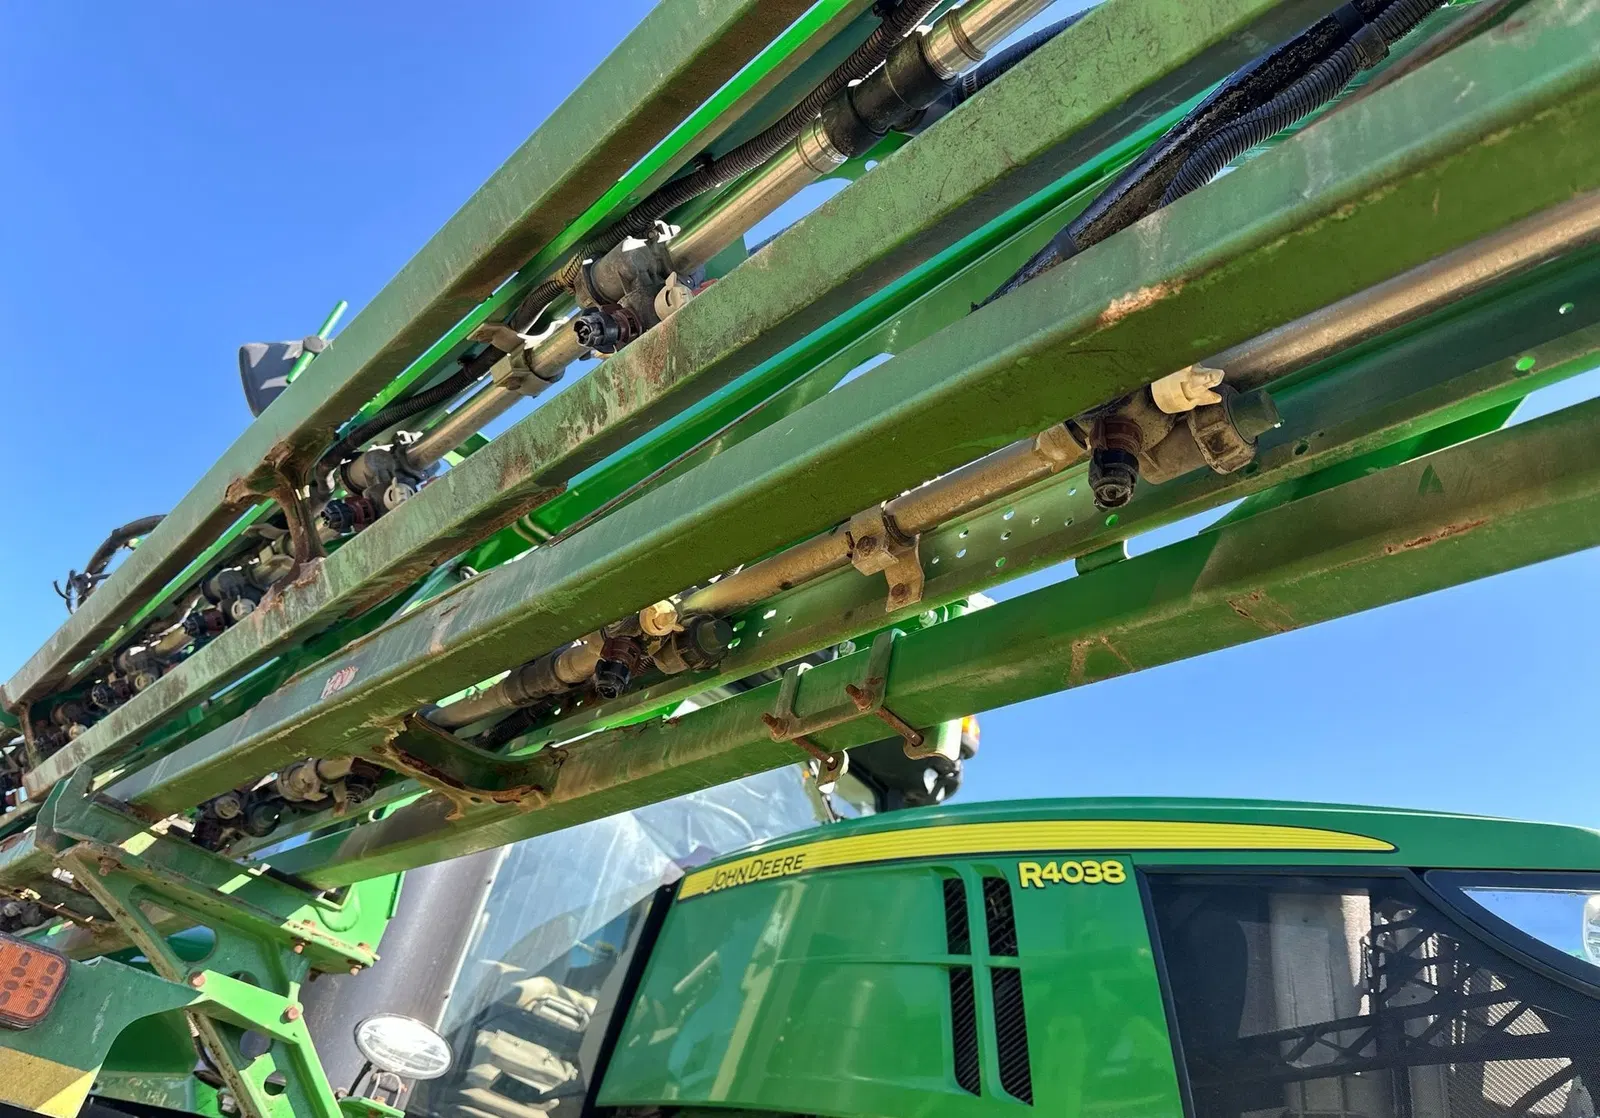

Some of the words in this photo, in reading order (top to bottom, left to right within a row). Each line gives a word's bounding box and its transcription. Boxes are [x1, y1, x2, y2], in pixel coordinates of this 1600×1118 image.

[707, 866, 749, 890] JOHN
[749, 853, 806, 879] DEERE
[1018, 860, 1127, 888] R4038
